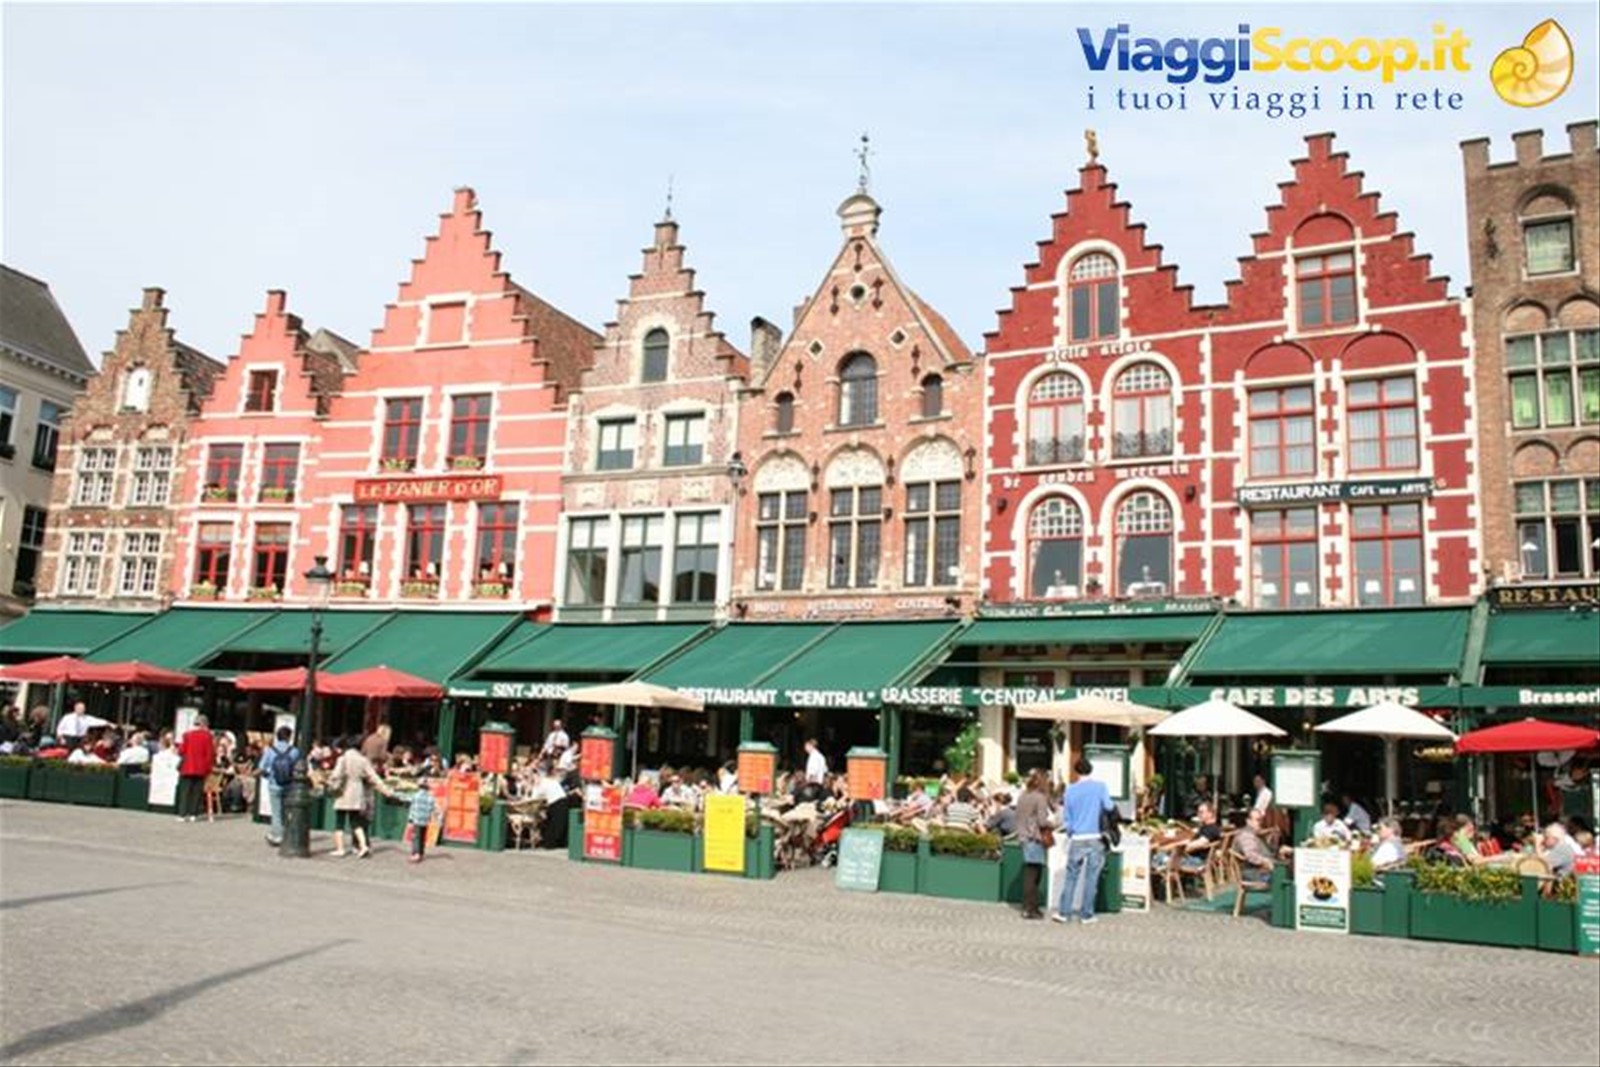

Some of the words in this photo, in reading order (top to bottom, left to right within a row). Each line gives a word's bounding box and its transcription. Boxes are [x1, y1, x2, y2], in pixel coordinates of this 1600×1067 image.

[386, 480, 449, 498] PANIER
[1240, 484, 1341, 502] RESTAURANT
[1401, 482, 1427, 495] ARTS
[1499, 587, 1600, 603] RESTAU
[785, 689, 874, 707] "CENTRAL"
[1209, 687, 1275, 706] CAFE
[1285, 687, 1335, 706] DES
[1346, 687, 1419, 706] ARTS
